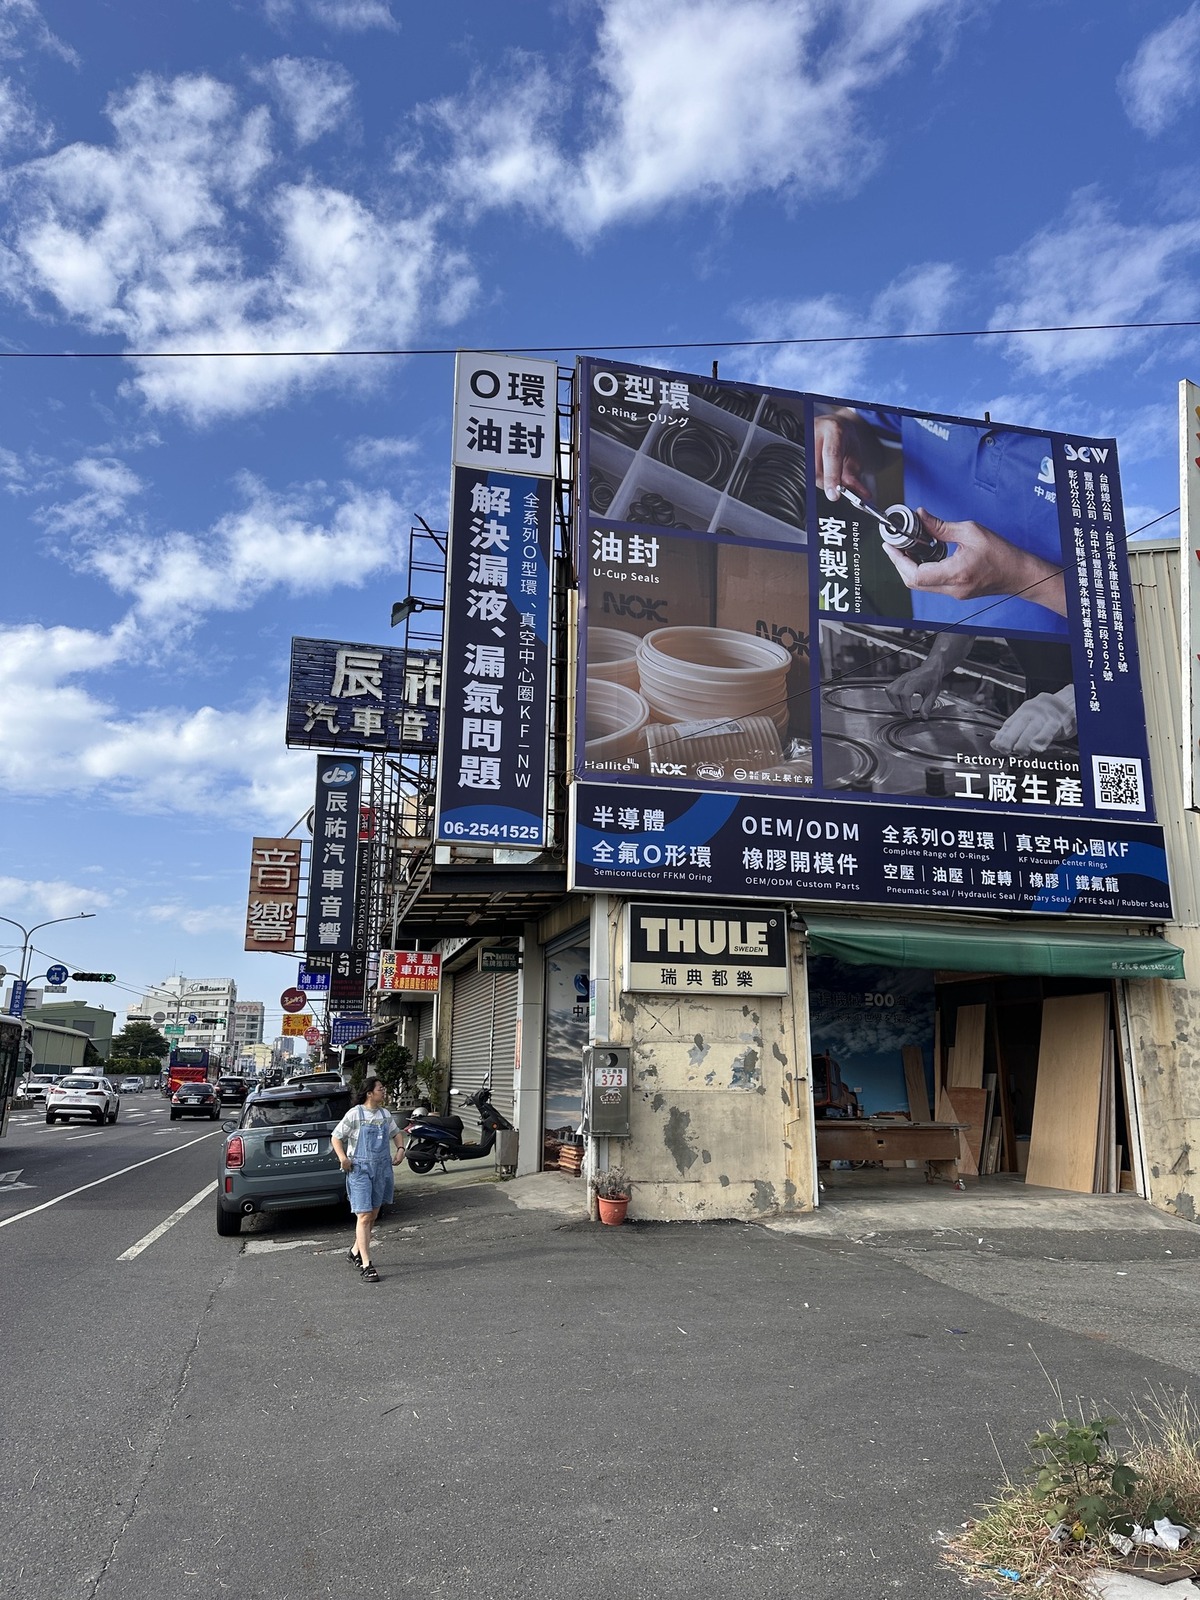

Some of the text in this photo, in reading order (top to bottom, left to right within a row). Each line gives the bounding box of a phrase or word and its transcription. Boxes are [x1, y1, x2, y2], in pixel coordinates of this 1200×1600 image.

[470, 369, 545, 409] O環
[593, 371, 690, 411] O型環
[598, 405, 638, 421] O-Ring
[466, 416, 545, 459] 油封
[591, 530, 660, 568] 油封
[593, 568, 660, 584] U-Cup Seals
[818, 516, 849, 613] 客製化
[851, 521, 862, 614] Rubber Customization
[603, 591, 668, 623] NOK
[458, 482, 511, 790] 解決漏液、漏氣問題
[585, 760, 630, 772] Hallite
[650, 762, 687, 777] NOK
[956, 753, 1080, 773] Factory Production
[954, 771, 1084, 807] 工廠生產
[443, 820, 539, 840] 06-2541525
[592, 806, 665, 832] 半導體
[741, 815, 860, 841] OEM/ODM
[882, 824, 995, 851] 全系列O型環
[1015, 833, 1129, 857] 真空中心圈KF
[592, 840, 712, 869] 全氟O形環
[742, 847, 859, 876] 橡膠開模件
[883, 847, 990, 861] Complete Range of O-Rings
[1030, 857, 1060, 866] Vacuum
[1062, 859, 1087, 867] Center
[1088, 860, 1108, 869] Rings
[318, 791, 348, 945] 辰祐汽車音響
[593, 868, 712, 883] Semiconductor FFKM Oring
[883, 863, 915, 881] 空壓
[932, 866, 964, 884] 油壓
[980, 869, 1012, 887] 旋轉
[745, 877, 860, 891] OEM/ODM Custom Parts
[1029, 872, 1060, 889] 橡膠
[250, 848, 297, 943] 音響
[886, 886, 930, 896] Pneumatic
[931, 889, 949, 897] Seal
[957, 889, 997, 900] Hydraulic
[999, 892, 1016, 900] Seal
[1023, 893, 1049, 903] Rotary
[1051, 895, 1072, 903] Seals
[1079, 897, 1097, 905] PTFE
[1099, 898, 1115, 906] Seal
[1122, 899, 1148, 908] Rubber
[1149, 900, 1170, 909] Seals
[640, 917, 768, 956] THULE
[734, 945, 764, 953] SWEDEN
[661, 967, 754, 988] 瑞典都樂
[602, 1074, 622, 1086] 373
